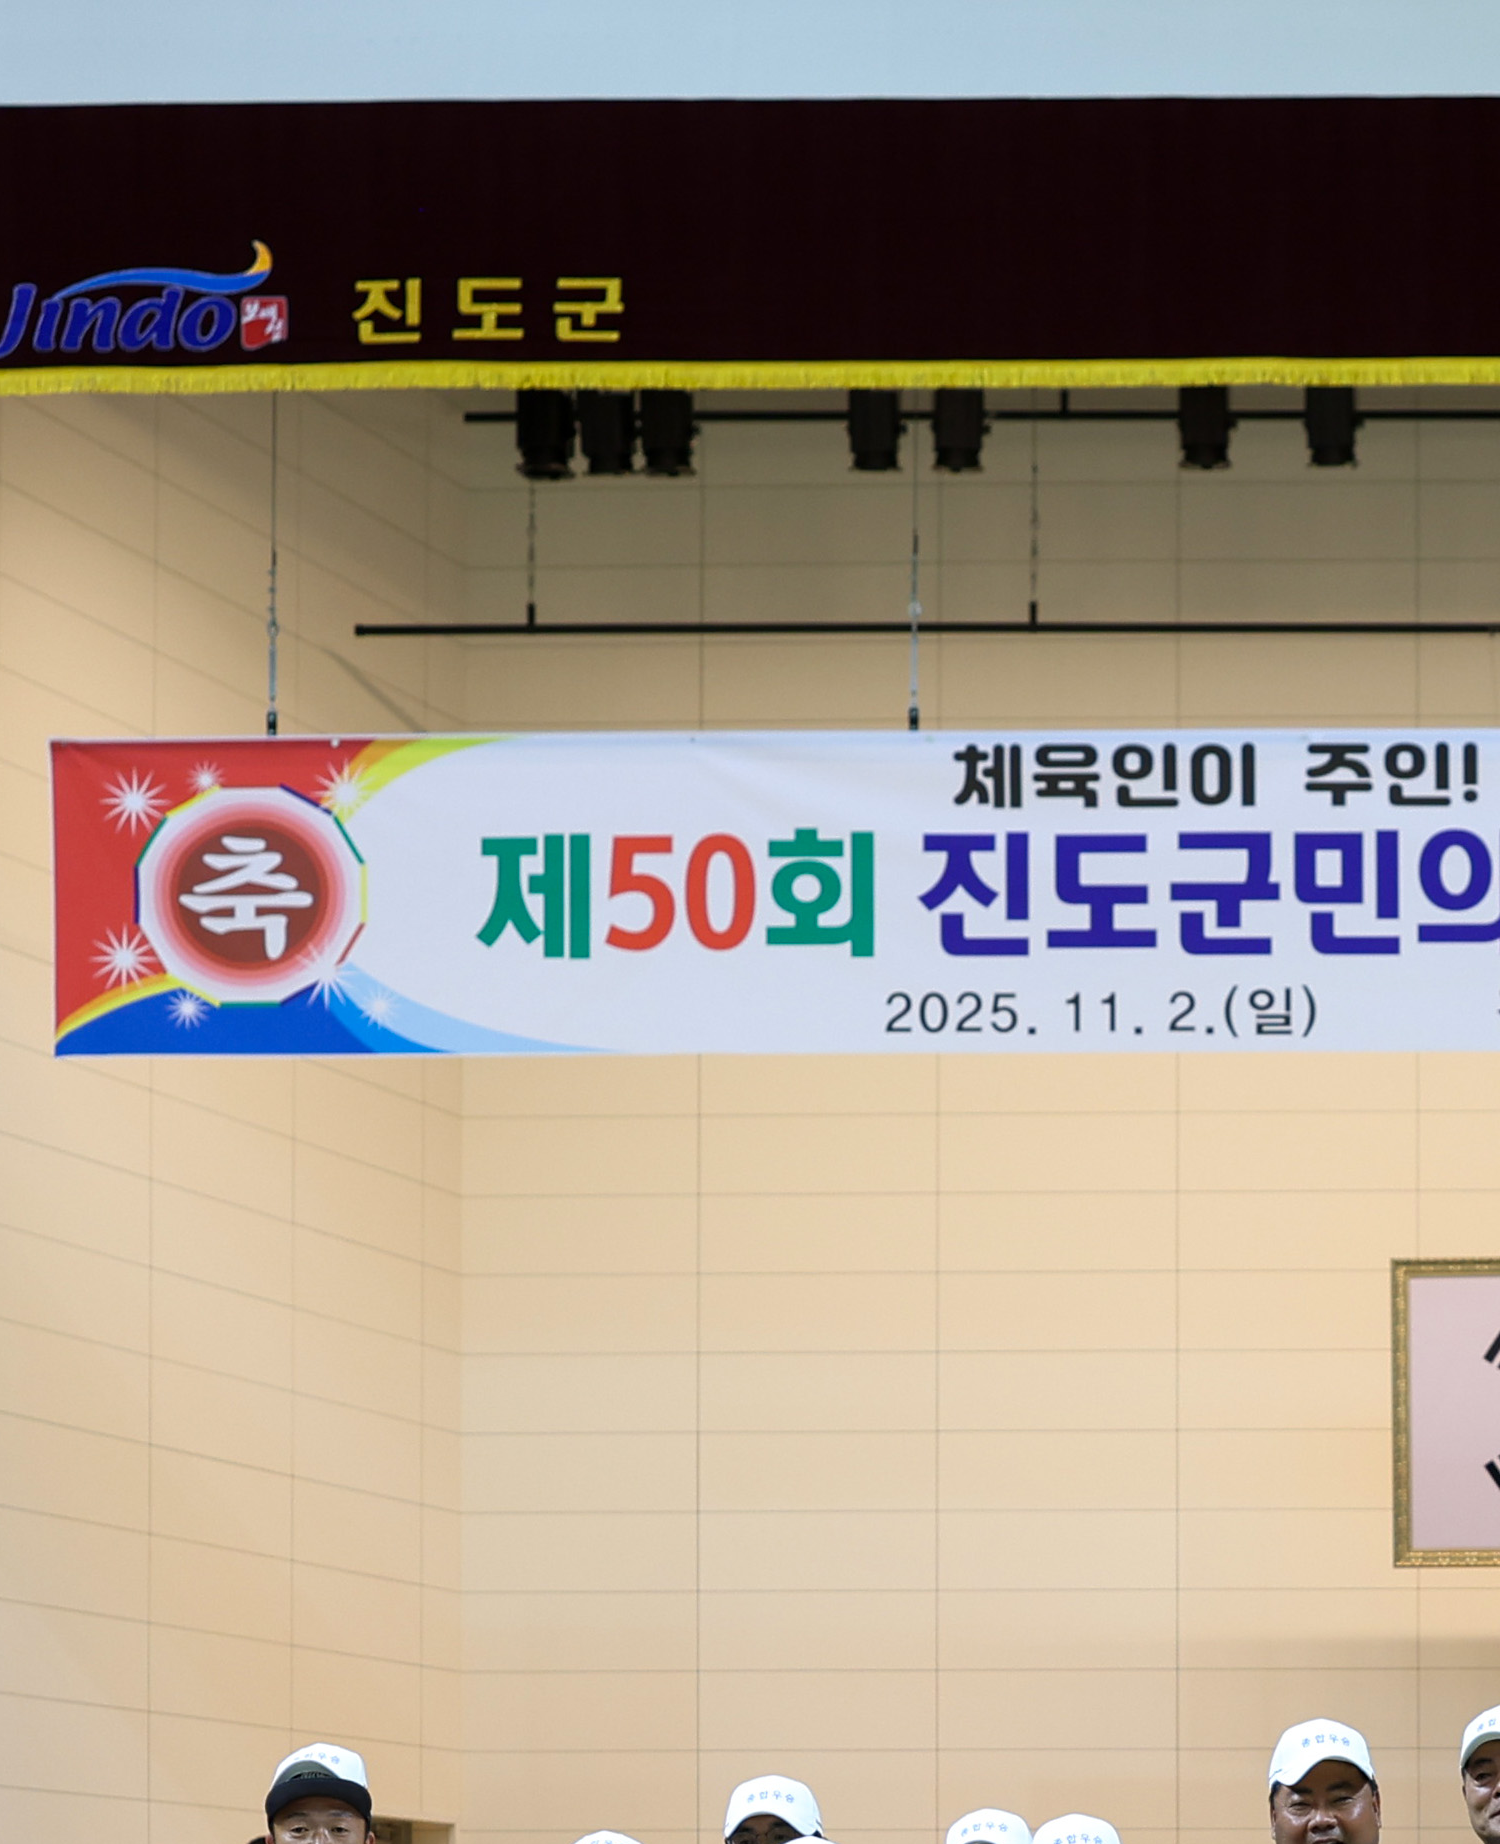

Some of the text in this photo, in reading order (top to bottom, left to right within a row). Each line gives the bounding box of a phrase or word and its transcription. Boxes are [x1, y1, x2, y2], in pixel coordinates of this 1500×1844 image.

[353, 278, 624, 344] 진도군
[953, 742, 1256, 809] 체육인이
[1305, 742, 1480, 807] 주인!
[177, 833, 316, 960] 축
[476, 828, 876, 959] 제50회
